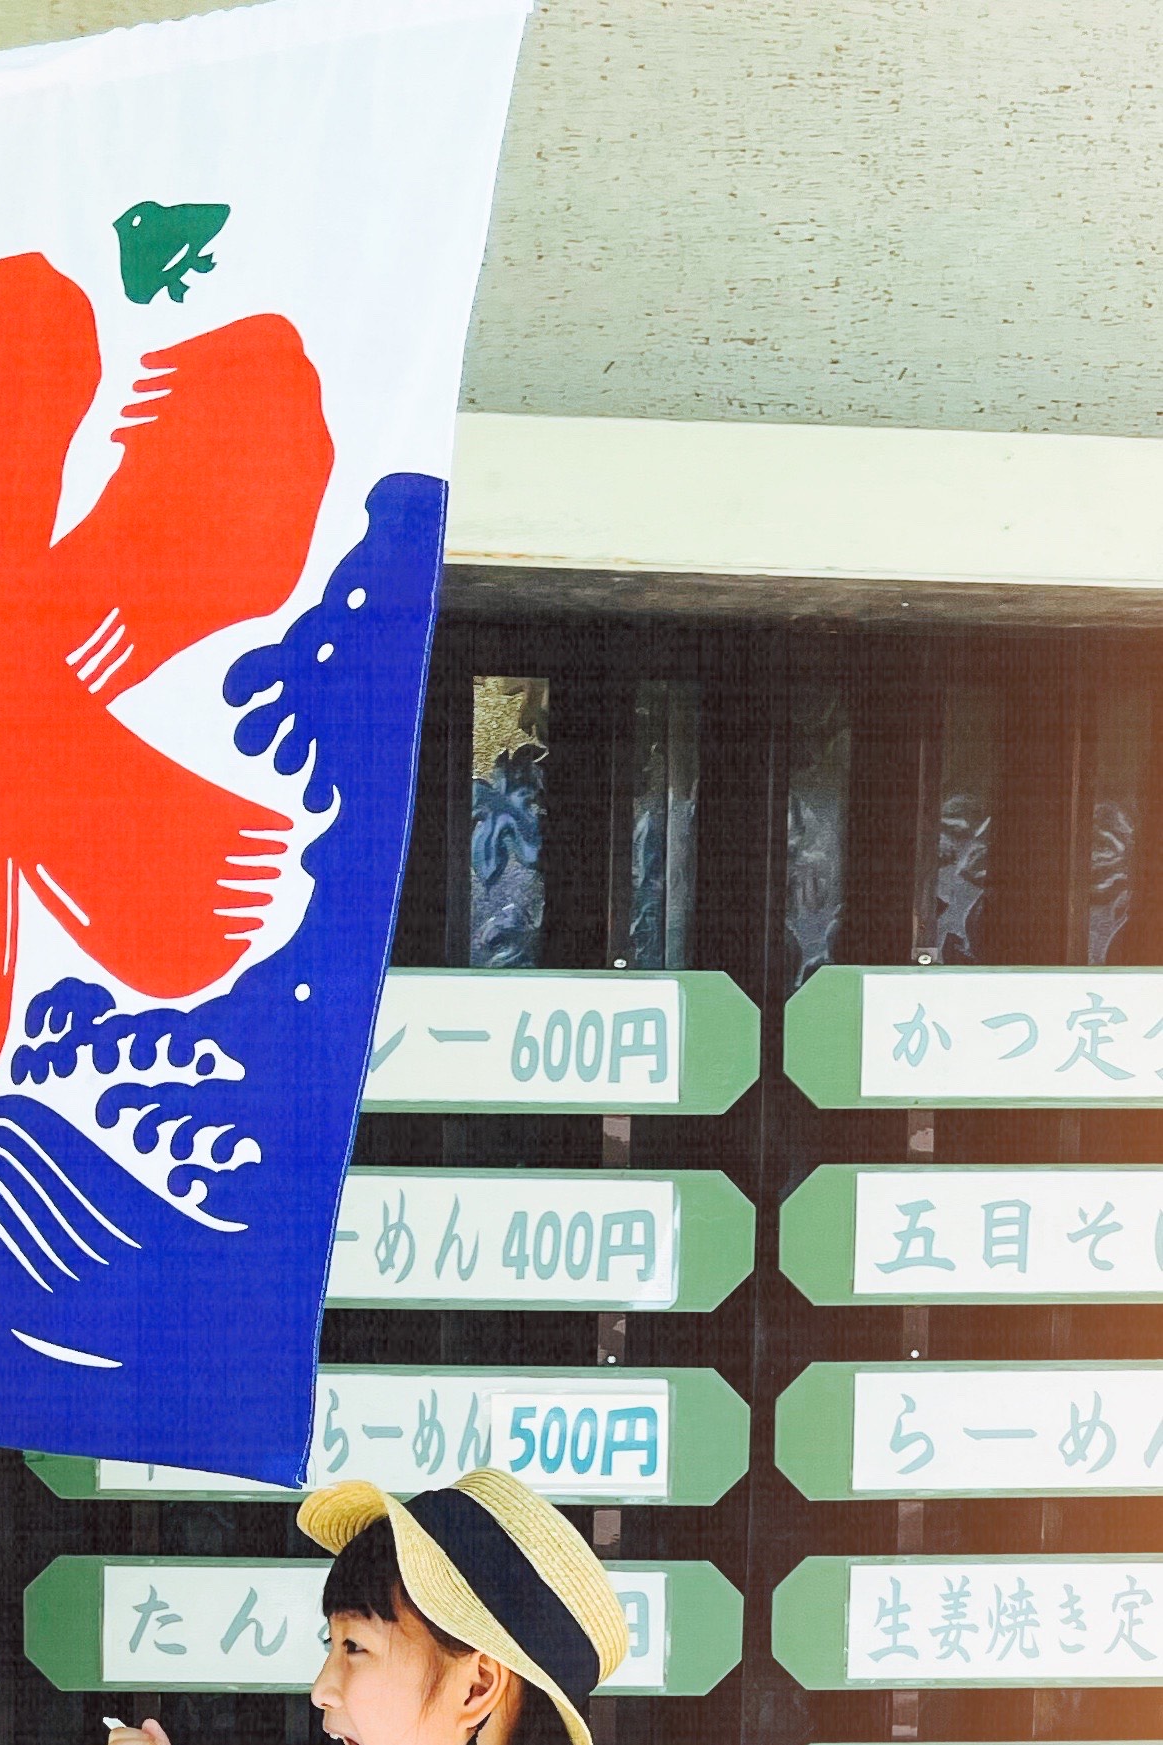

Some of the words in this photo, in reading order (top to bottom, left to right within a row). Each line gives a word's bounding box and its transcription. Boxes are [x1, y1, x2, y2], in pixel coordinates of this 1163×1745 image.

[510, 1007, 668, 1084] 600円
[892, 991, 1163, 1081] かつ定
[502, 1209, 656, 1282] 400円
[874, 1198, 1163, 1275] 五目そ
[509, 1405, 658, 1477] 500円
[889, 1390, 1163, 1475] らーめ
[128, 1583, 332, 1657] たん
[866, 1574, 1158, 1663] 生姜焼き定
